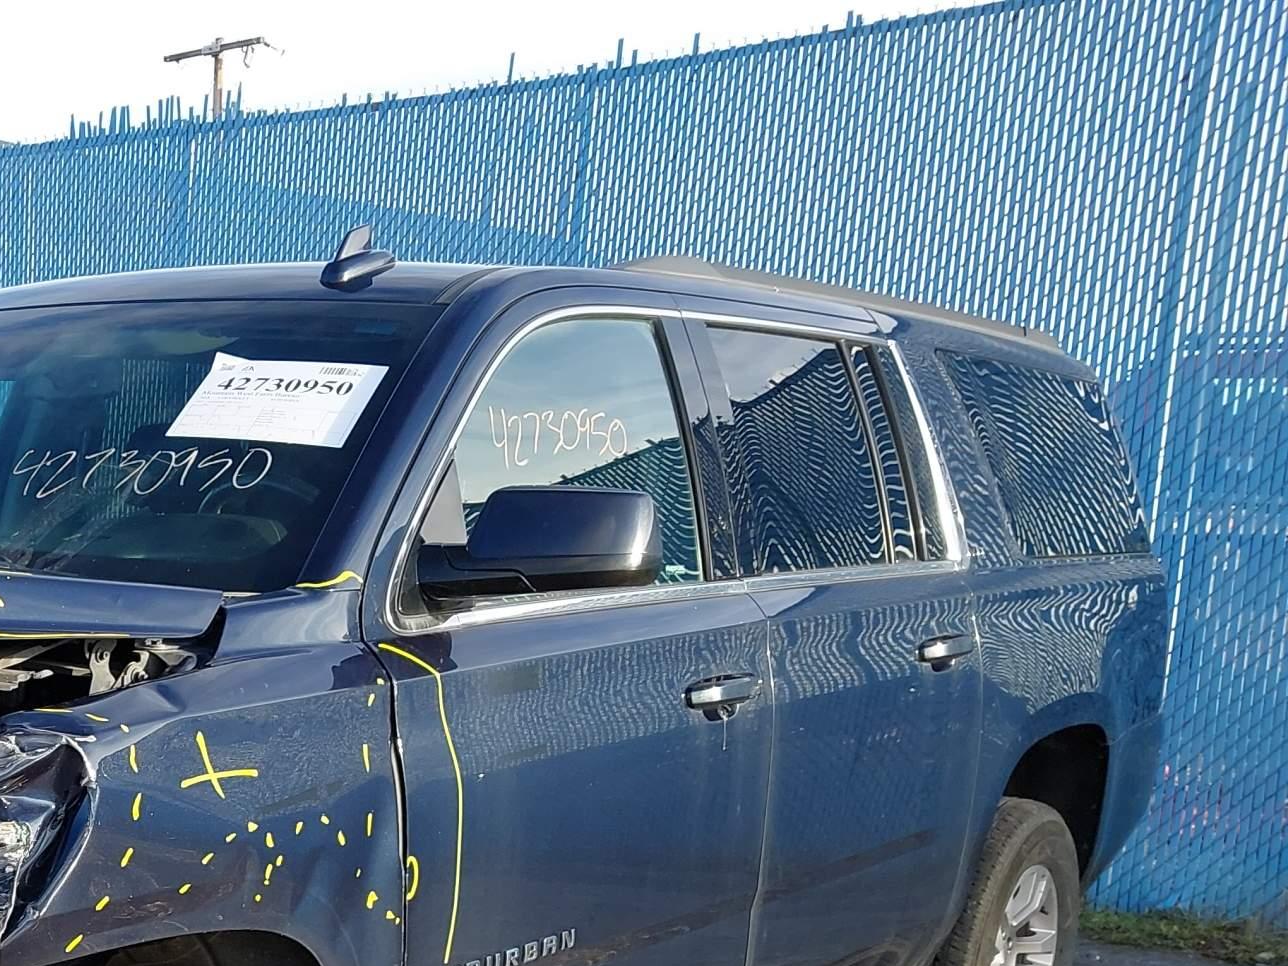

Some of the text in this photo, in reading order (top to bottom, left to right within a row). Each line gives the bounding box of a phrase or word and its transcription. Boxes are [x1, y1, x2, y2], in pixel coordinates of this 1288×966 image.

[217, 376, 354, 396] 42730950
[489, 406, 627, 470] 42730950
[12, 447, 273, 499] 42730950
